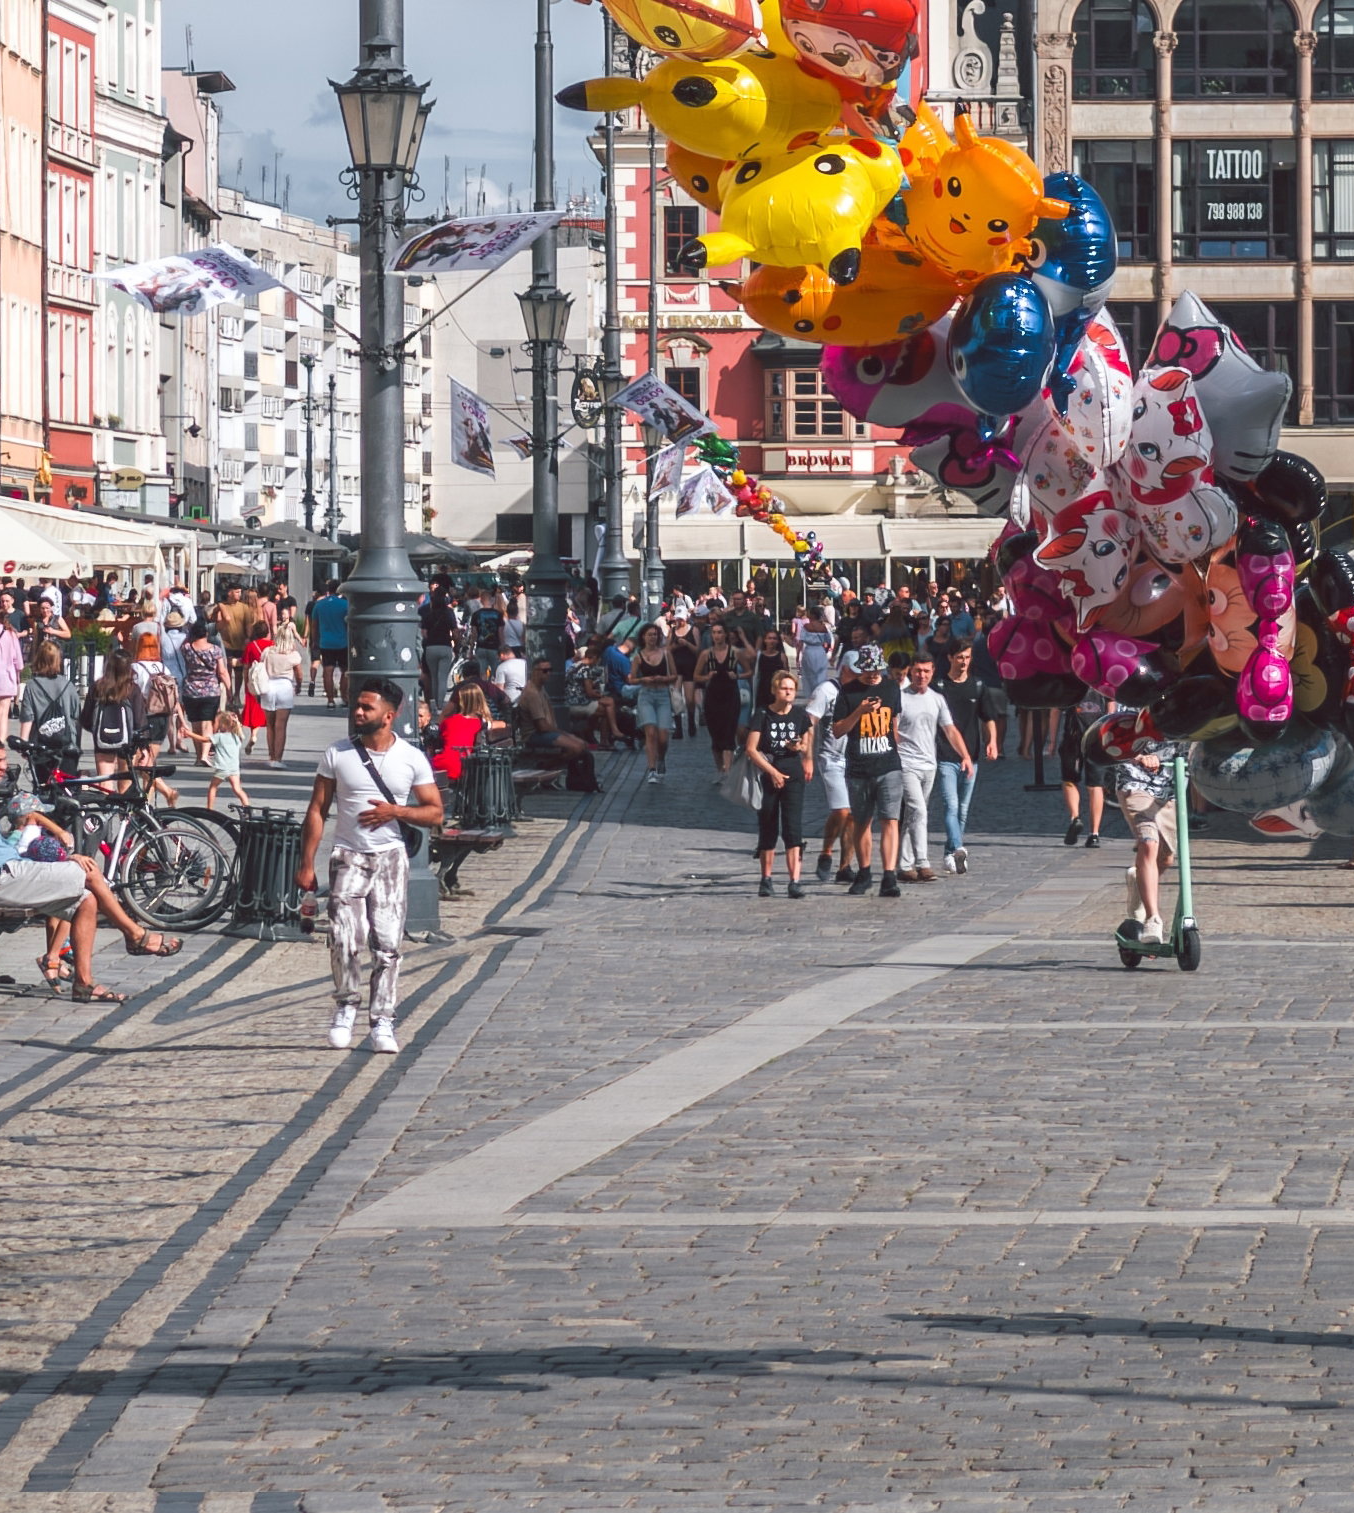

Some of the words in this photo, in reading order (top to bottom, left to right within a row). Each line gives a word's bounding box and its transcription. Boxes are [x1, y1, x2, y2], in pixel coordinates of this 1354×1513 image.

[1206, 149, 1262, 179] TATTOO
[1207, 202, 1224, 220] 798
[1227, 202, 1245, 220] 988
[1247, 202, 1262, 220] 138
[788, 455, 852, 466] BROWAR
